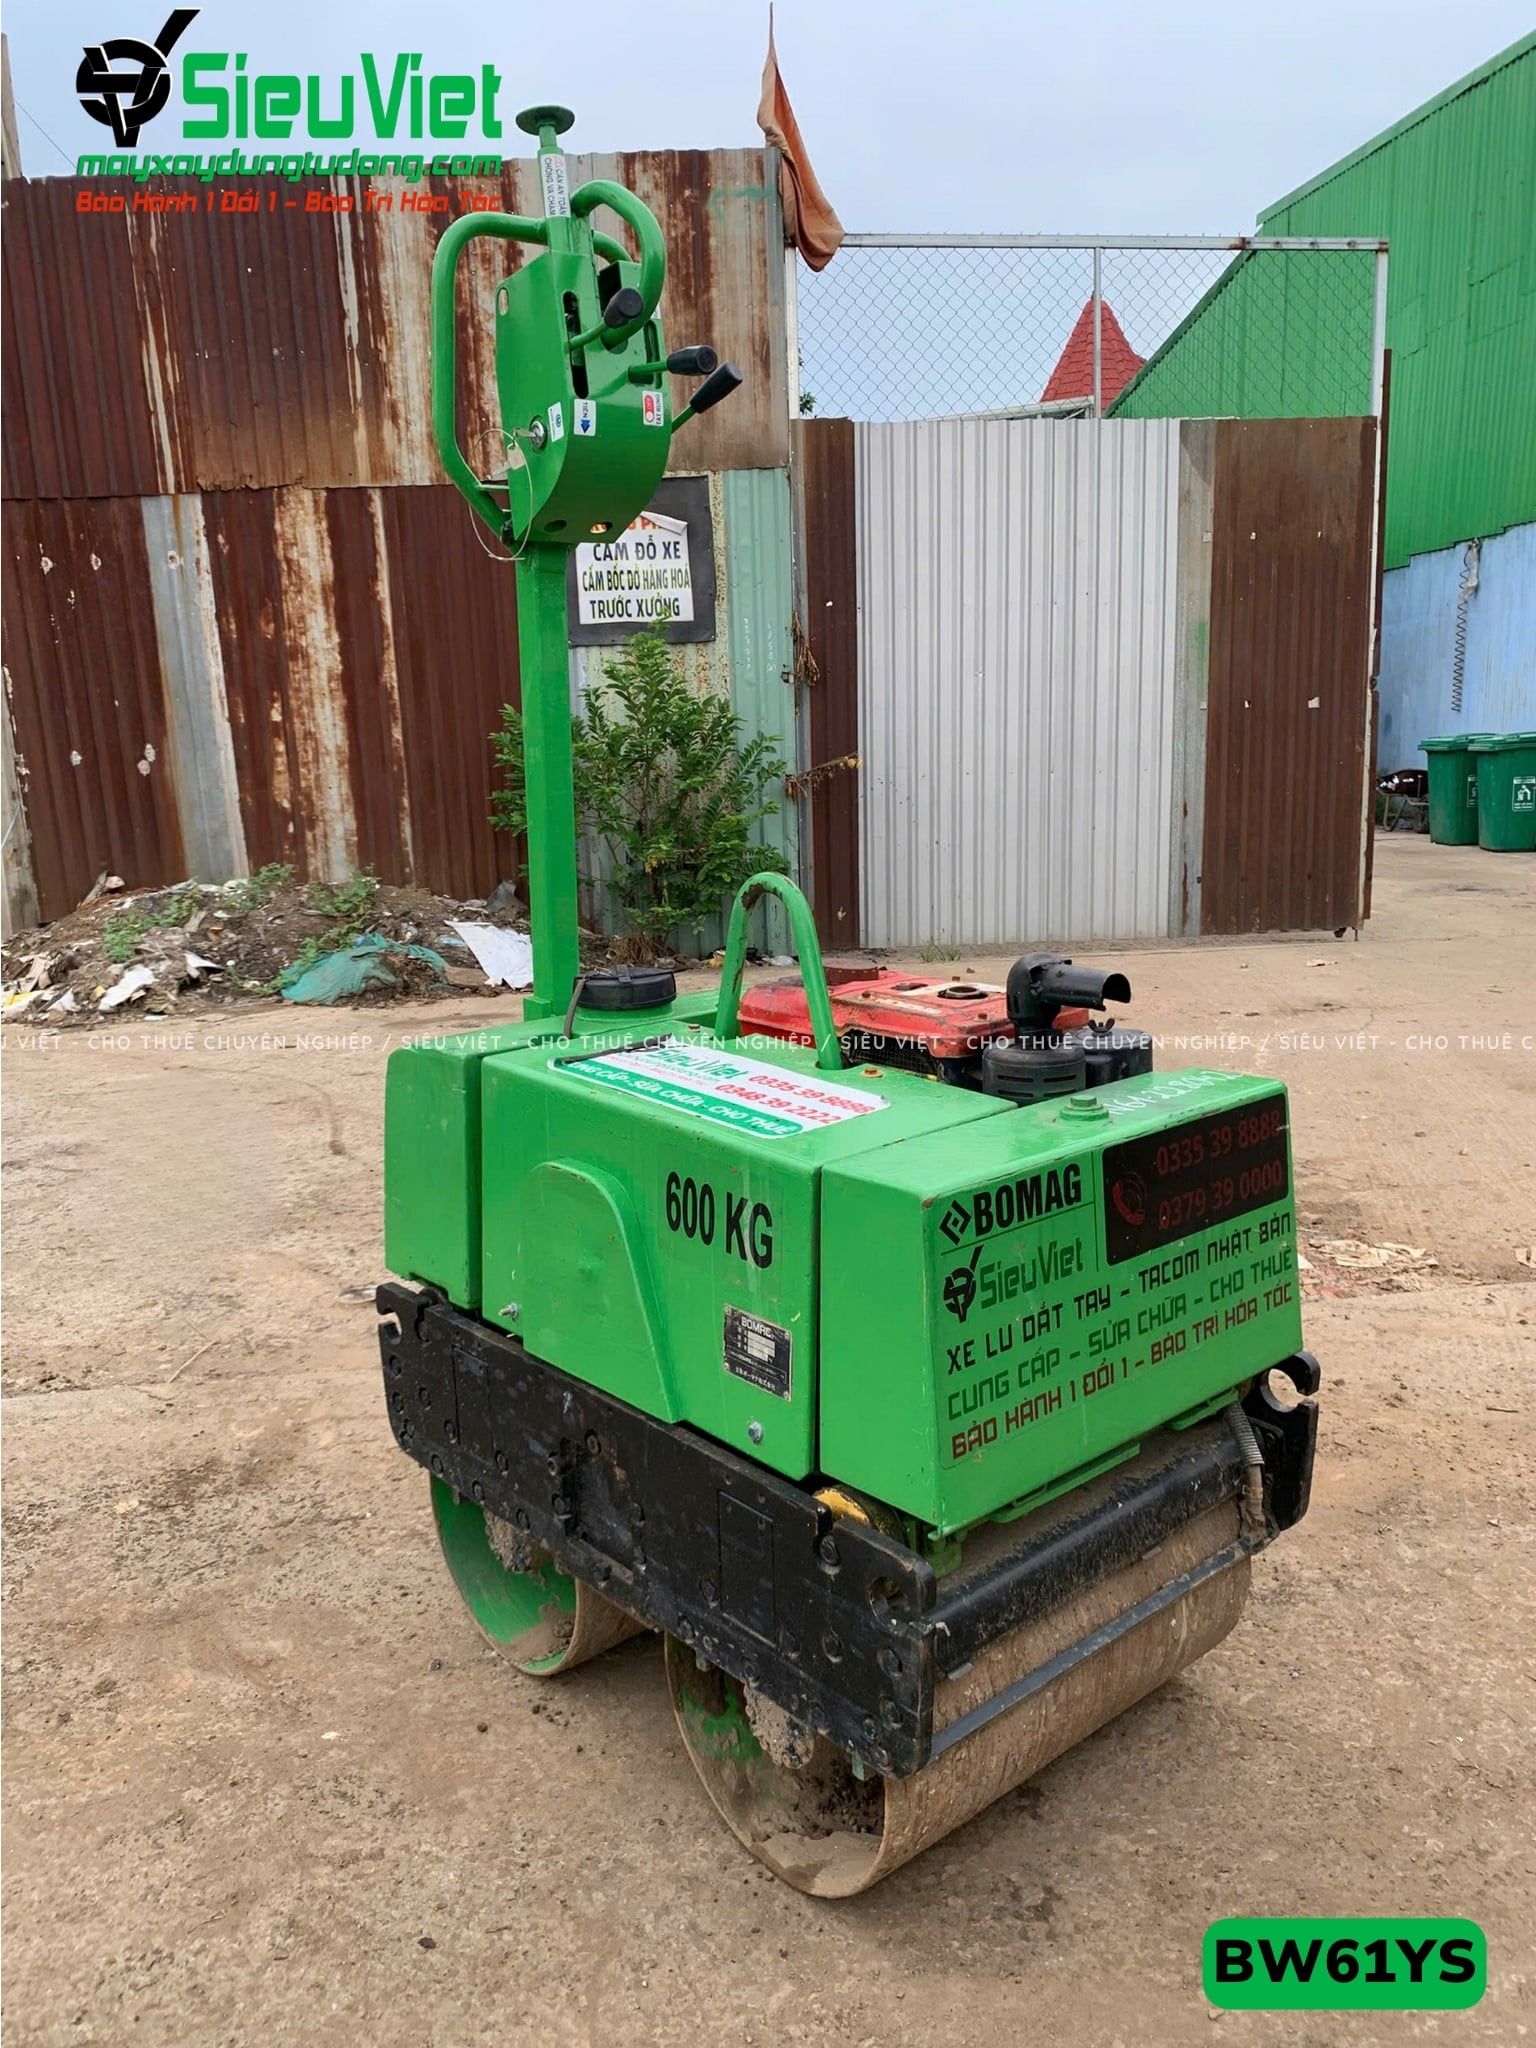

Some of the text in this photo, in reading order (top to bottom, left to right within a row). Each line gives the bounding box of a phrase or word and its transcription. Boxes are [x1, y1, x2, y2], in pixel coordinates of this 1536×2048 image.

[607, 563, 625, 591] BỐC
[643, 563, 669, 591] HÀNG
[662, 541, 681, 560] XE
[590, 595, 632, 619] TRƯỚC
[708, 1105, 748, 1121] CHO
[748, 1075, 796, 1092] 0335
[793, 1087, 825, 1099] 39
[759, 1095, 792, 1108] 39
[784, 1105, 842, 1124] 2222
[1156, 1110, 1281, 1175] 0335 39 8888
[665, 1171, 773, 1269] 600 KG
[973, 1163, 1082, 1237] BOMAG
[1159, 1160, 1283, 1229] 0379 39 0000
[980, 1237, 1084, 1309] SieuViet
[946, 1339, 976, 1375] XE
[986, 1324, 1013, 1359] LU
[1073, 1285, 1111, 1319] TAY
[1138, 1249, 1199, 1293] TACOM
[948, 1369, 1010, 1420] CUNG
[1209, 1268, 1244, 1303] CHO
[1250, 1247, 1292, 1285] THUÊ
[1069, 1380, 1076, 1402] 1
[1121, 1356, 1128, 1379] 1
